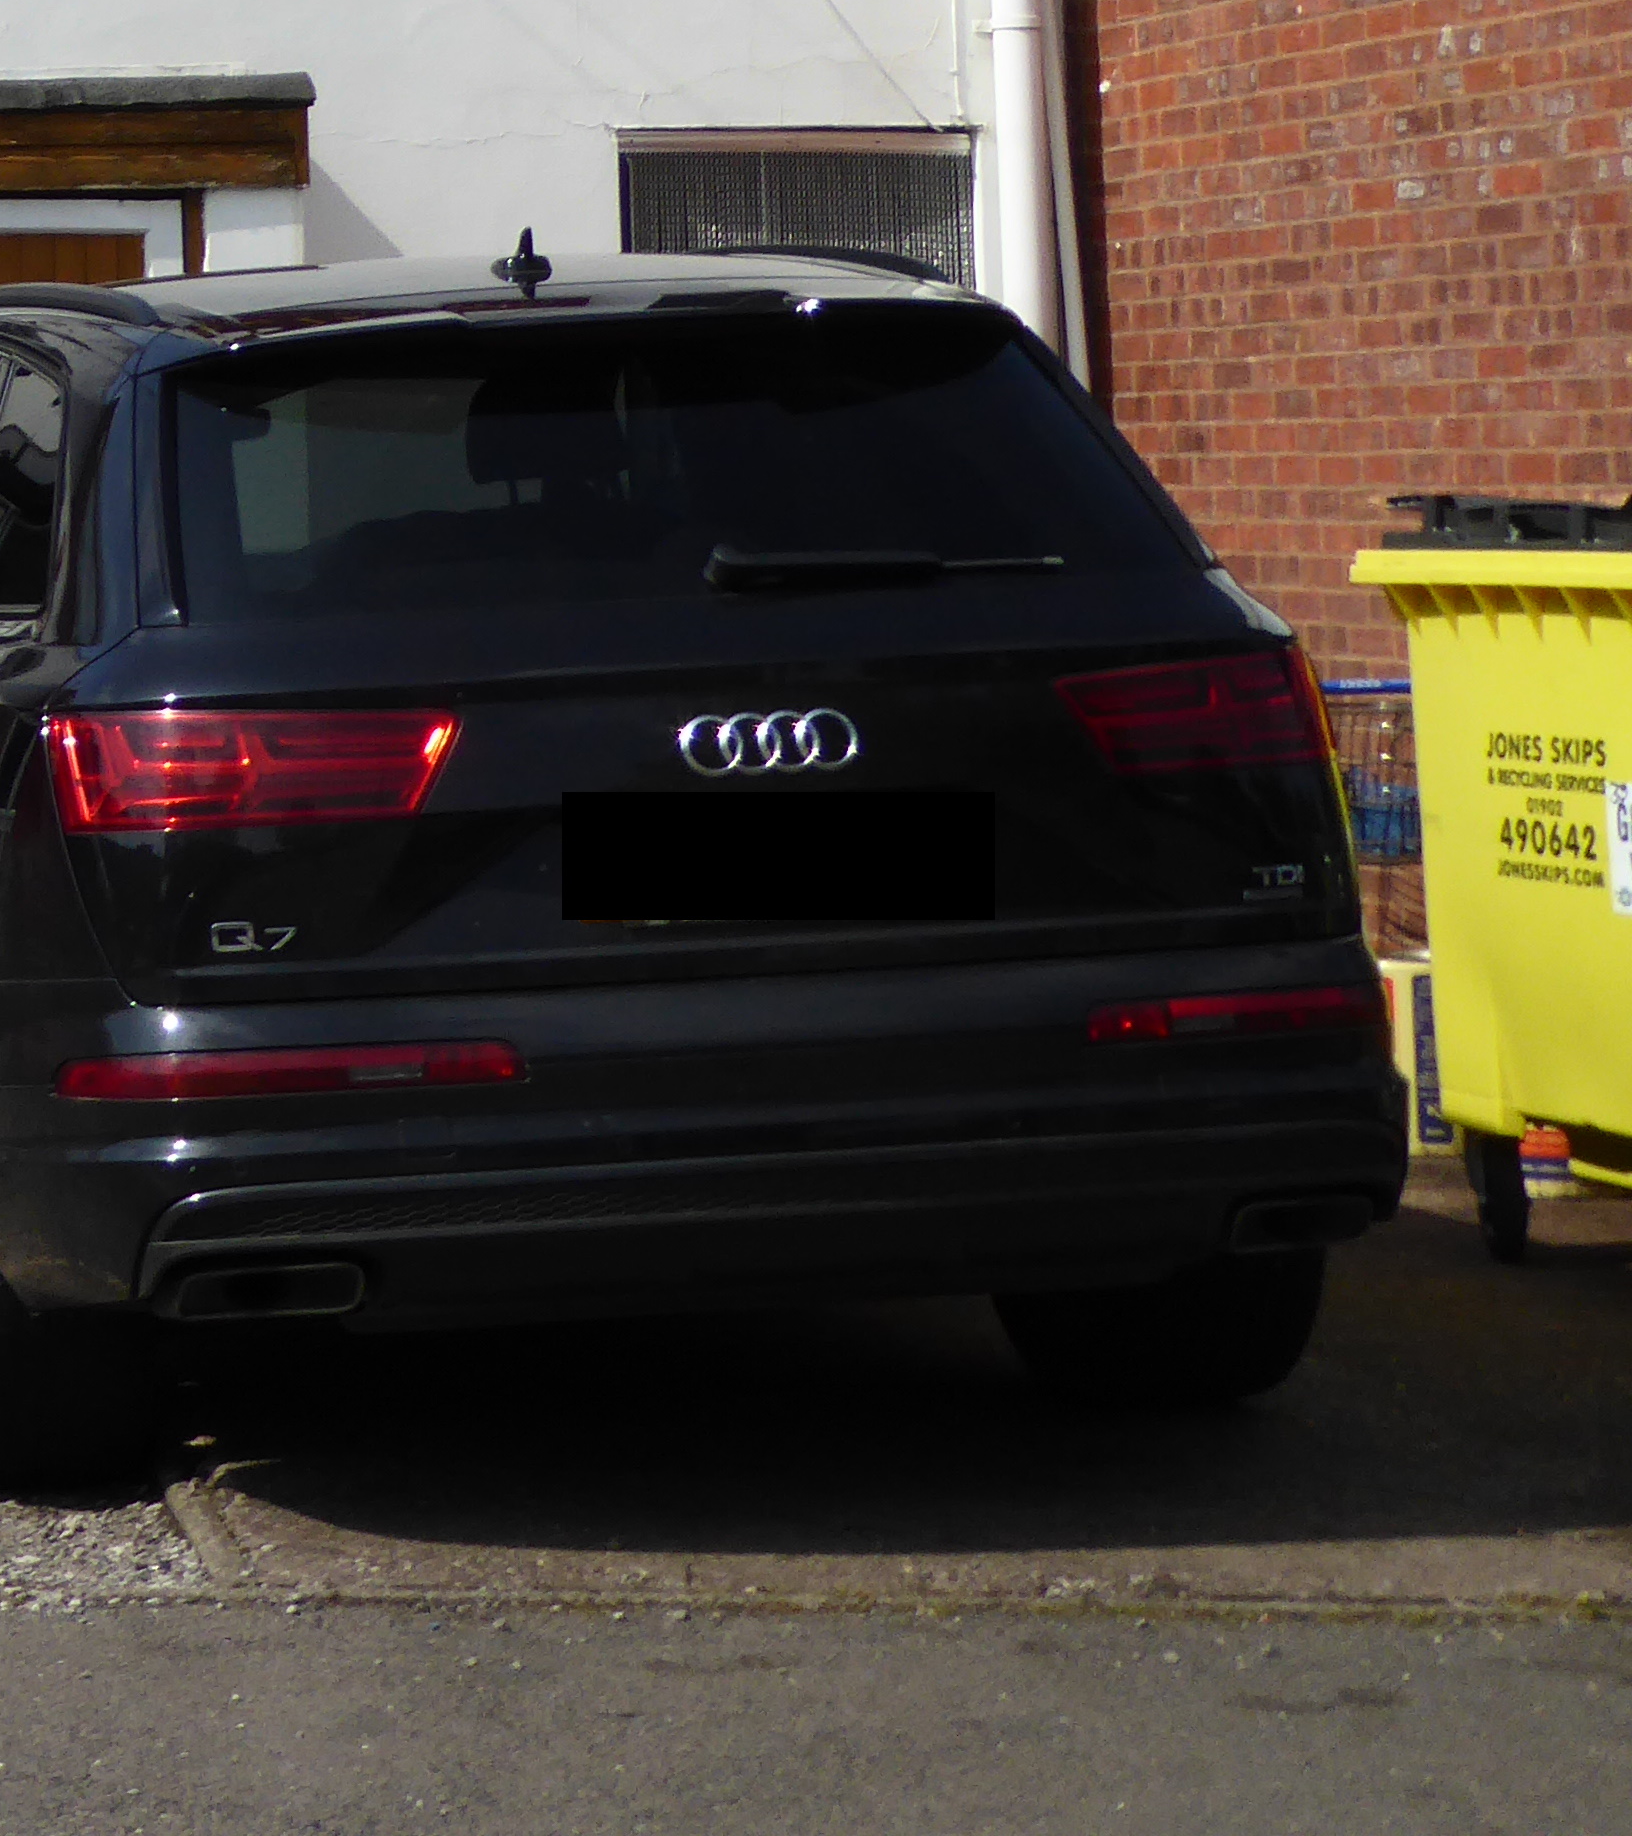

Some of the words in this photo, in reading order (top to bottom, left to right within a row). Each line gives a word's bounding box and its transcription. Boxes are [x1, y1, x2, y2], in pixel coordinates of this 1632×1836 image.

[1486, 731, 1543, 762] JONES
[1550, 736, 1607, 767] SKIPS
[1497, 767, 1553, 790] RECYCLING
[1556, 773, 1606, 795] SERVICES
[1500, 816, 1598, 861] 490642
[1252, 864, 1304, 886] TDI
[211, 921, 297, 952] Q7
